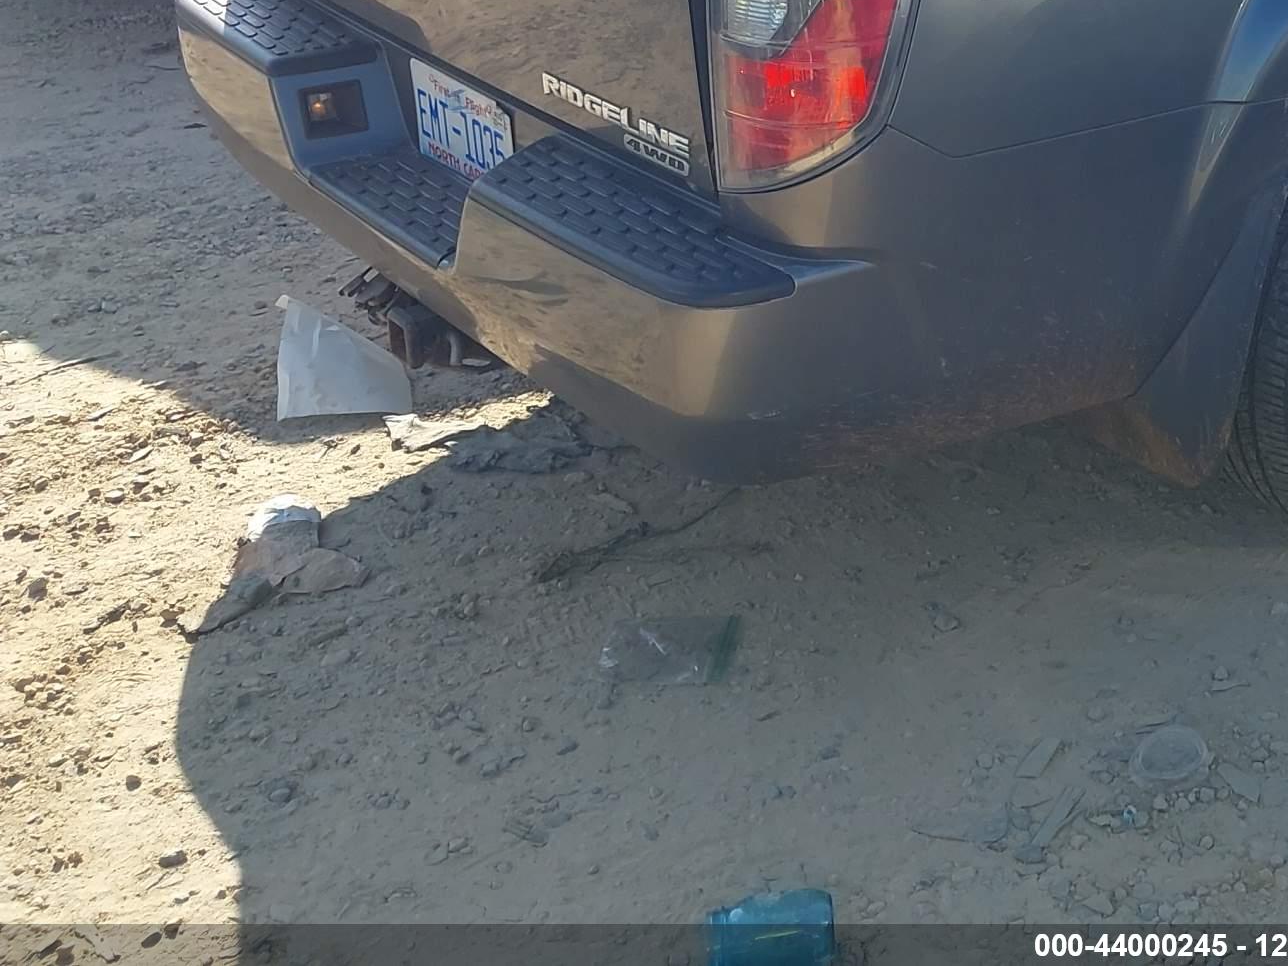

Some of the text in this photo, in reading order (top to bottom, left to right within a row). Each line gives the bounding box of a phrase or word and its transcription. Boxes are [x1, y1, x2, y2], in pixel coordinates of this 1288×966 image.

[417, 88, 504, 171] EMT-1035
[541, 71, 690, 159] RIDGELINE
[427, 141, 484, 180] NORTH CAR
[626, 136, 687, 174] 4WD
